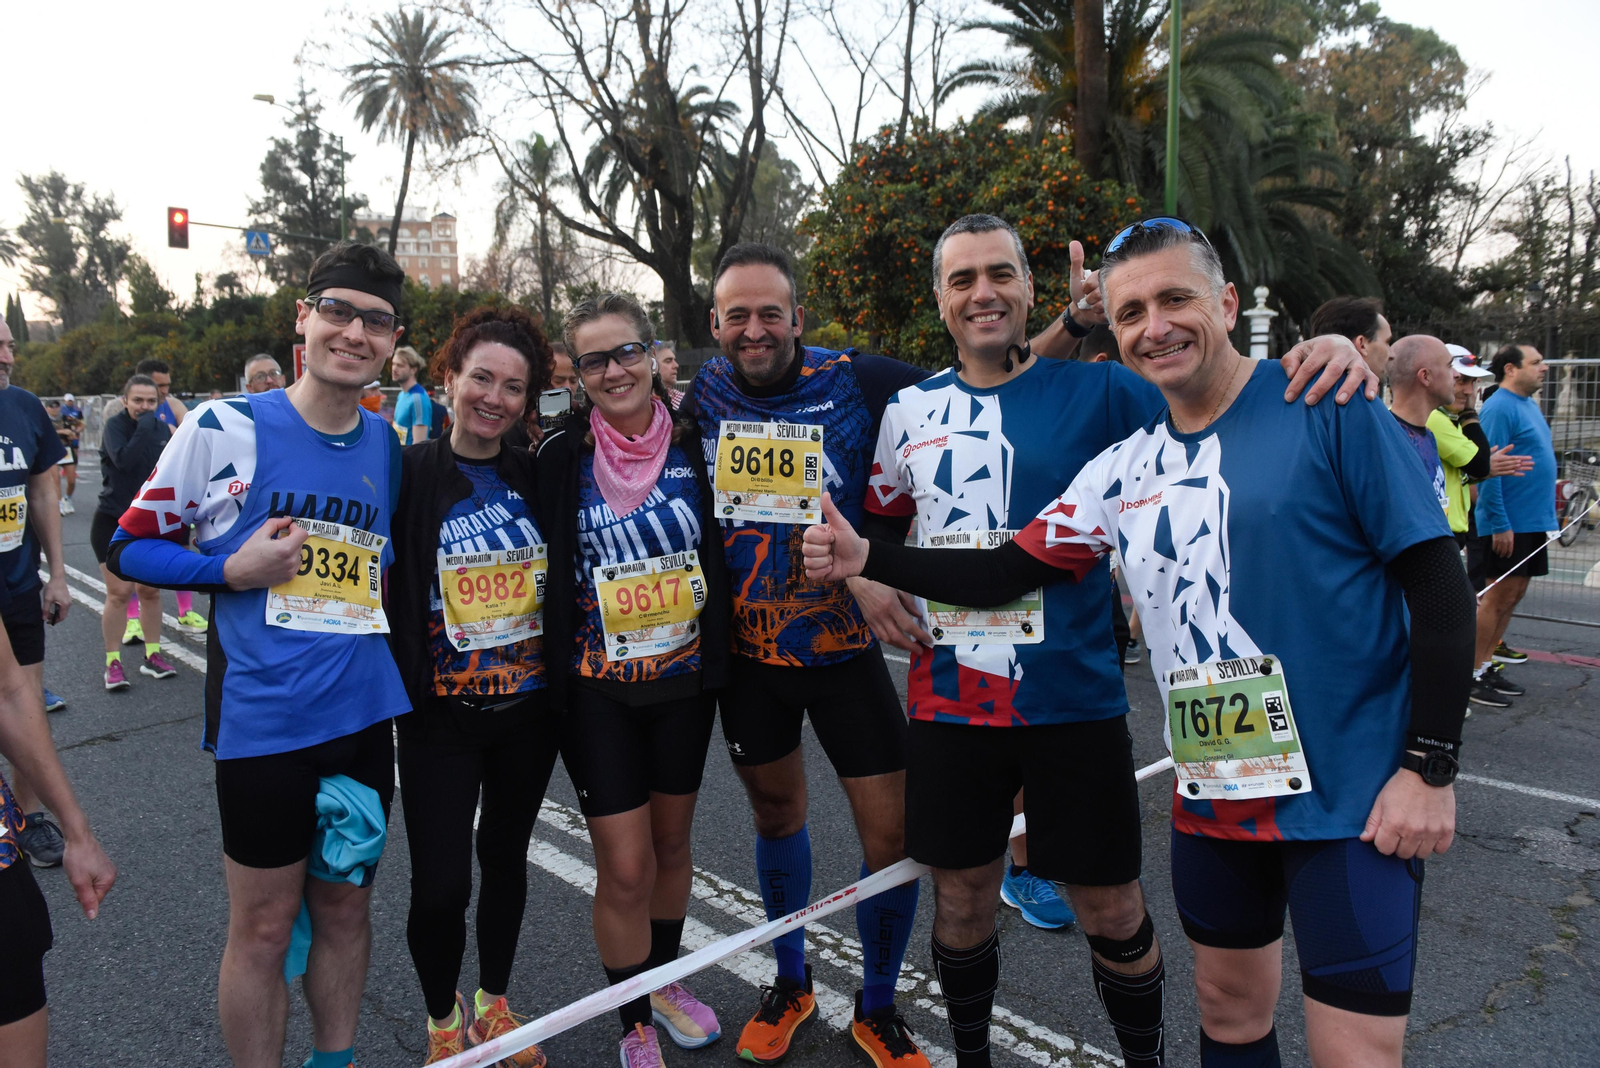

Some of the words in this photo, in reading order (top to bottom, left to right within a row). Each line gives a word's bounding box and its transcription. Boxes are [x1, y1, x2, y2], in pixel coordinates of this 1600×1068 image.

[726, 423, 741, 433] MEDIO
[742, 423, 764, 434] MARATÓN
[777, 425, 807, 438] SEVILLA
[911, 435, 949, 452] DOPAMINE
[730, 445, 794, 478] 9618
[664, 467, 698, 479] HOKA
[1126, 491, 1163, 510] DOPAMINE
[440, 502, 513, 544] MARATÓN
[312, 522, 340, 536] MARATÓN
[350, 528, 376, 547] SEVILLA
[930, 535, 945, 547] MEDIO
[946, 532, 971, 545] MARATÓN
[295, 543, 361, 586] 9334
[445, 556, 464, 566] MEDIO
[465, 553, 492, 564] MARATÓN
[506, 547, 534, 562] SEVILLA
[620, 561, 646, 573] MARATÓN
[660, 553, 687, 570] SEVILLA
[457, 571, 527, 605] 9982
[615, 577, 680, 615] 9617
[323, 618, 341, 626] HOKA
[655, 641, 670, 649] HOKA
[1175, 668, 1199, 684] MARATÓN
[1216, 659, 1260, 679] SEVILLA
[1174, 692, 1255, 739] 7672
[761, 868, 791, 926] alenji
